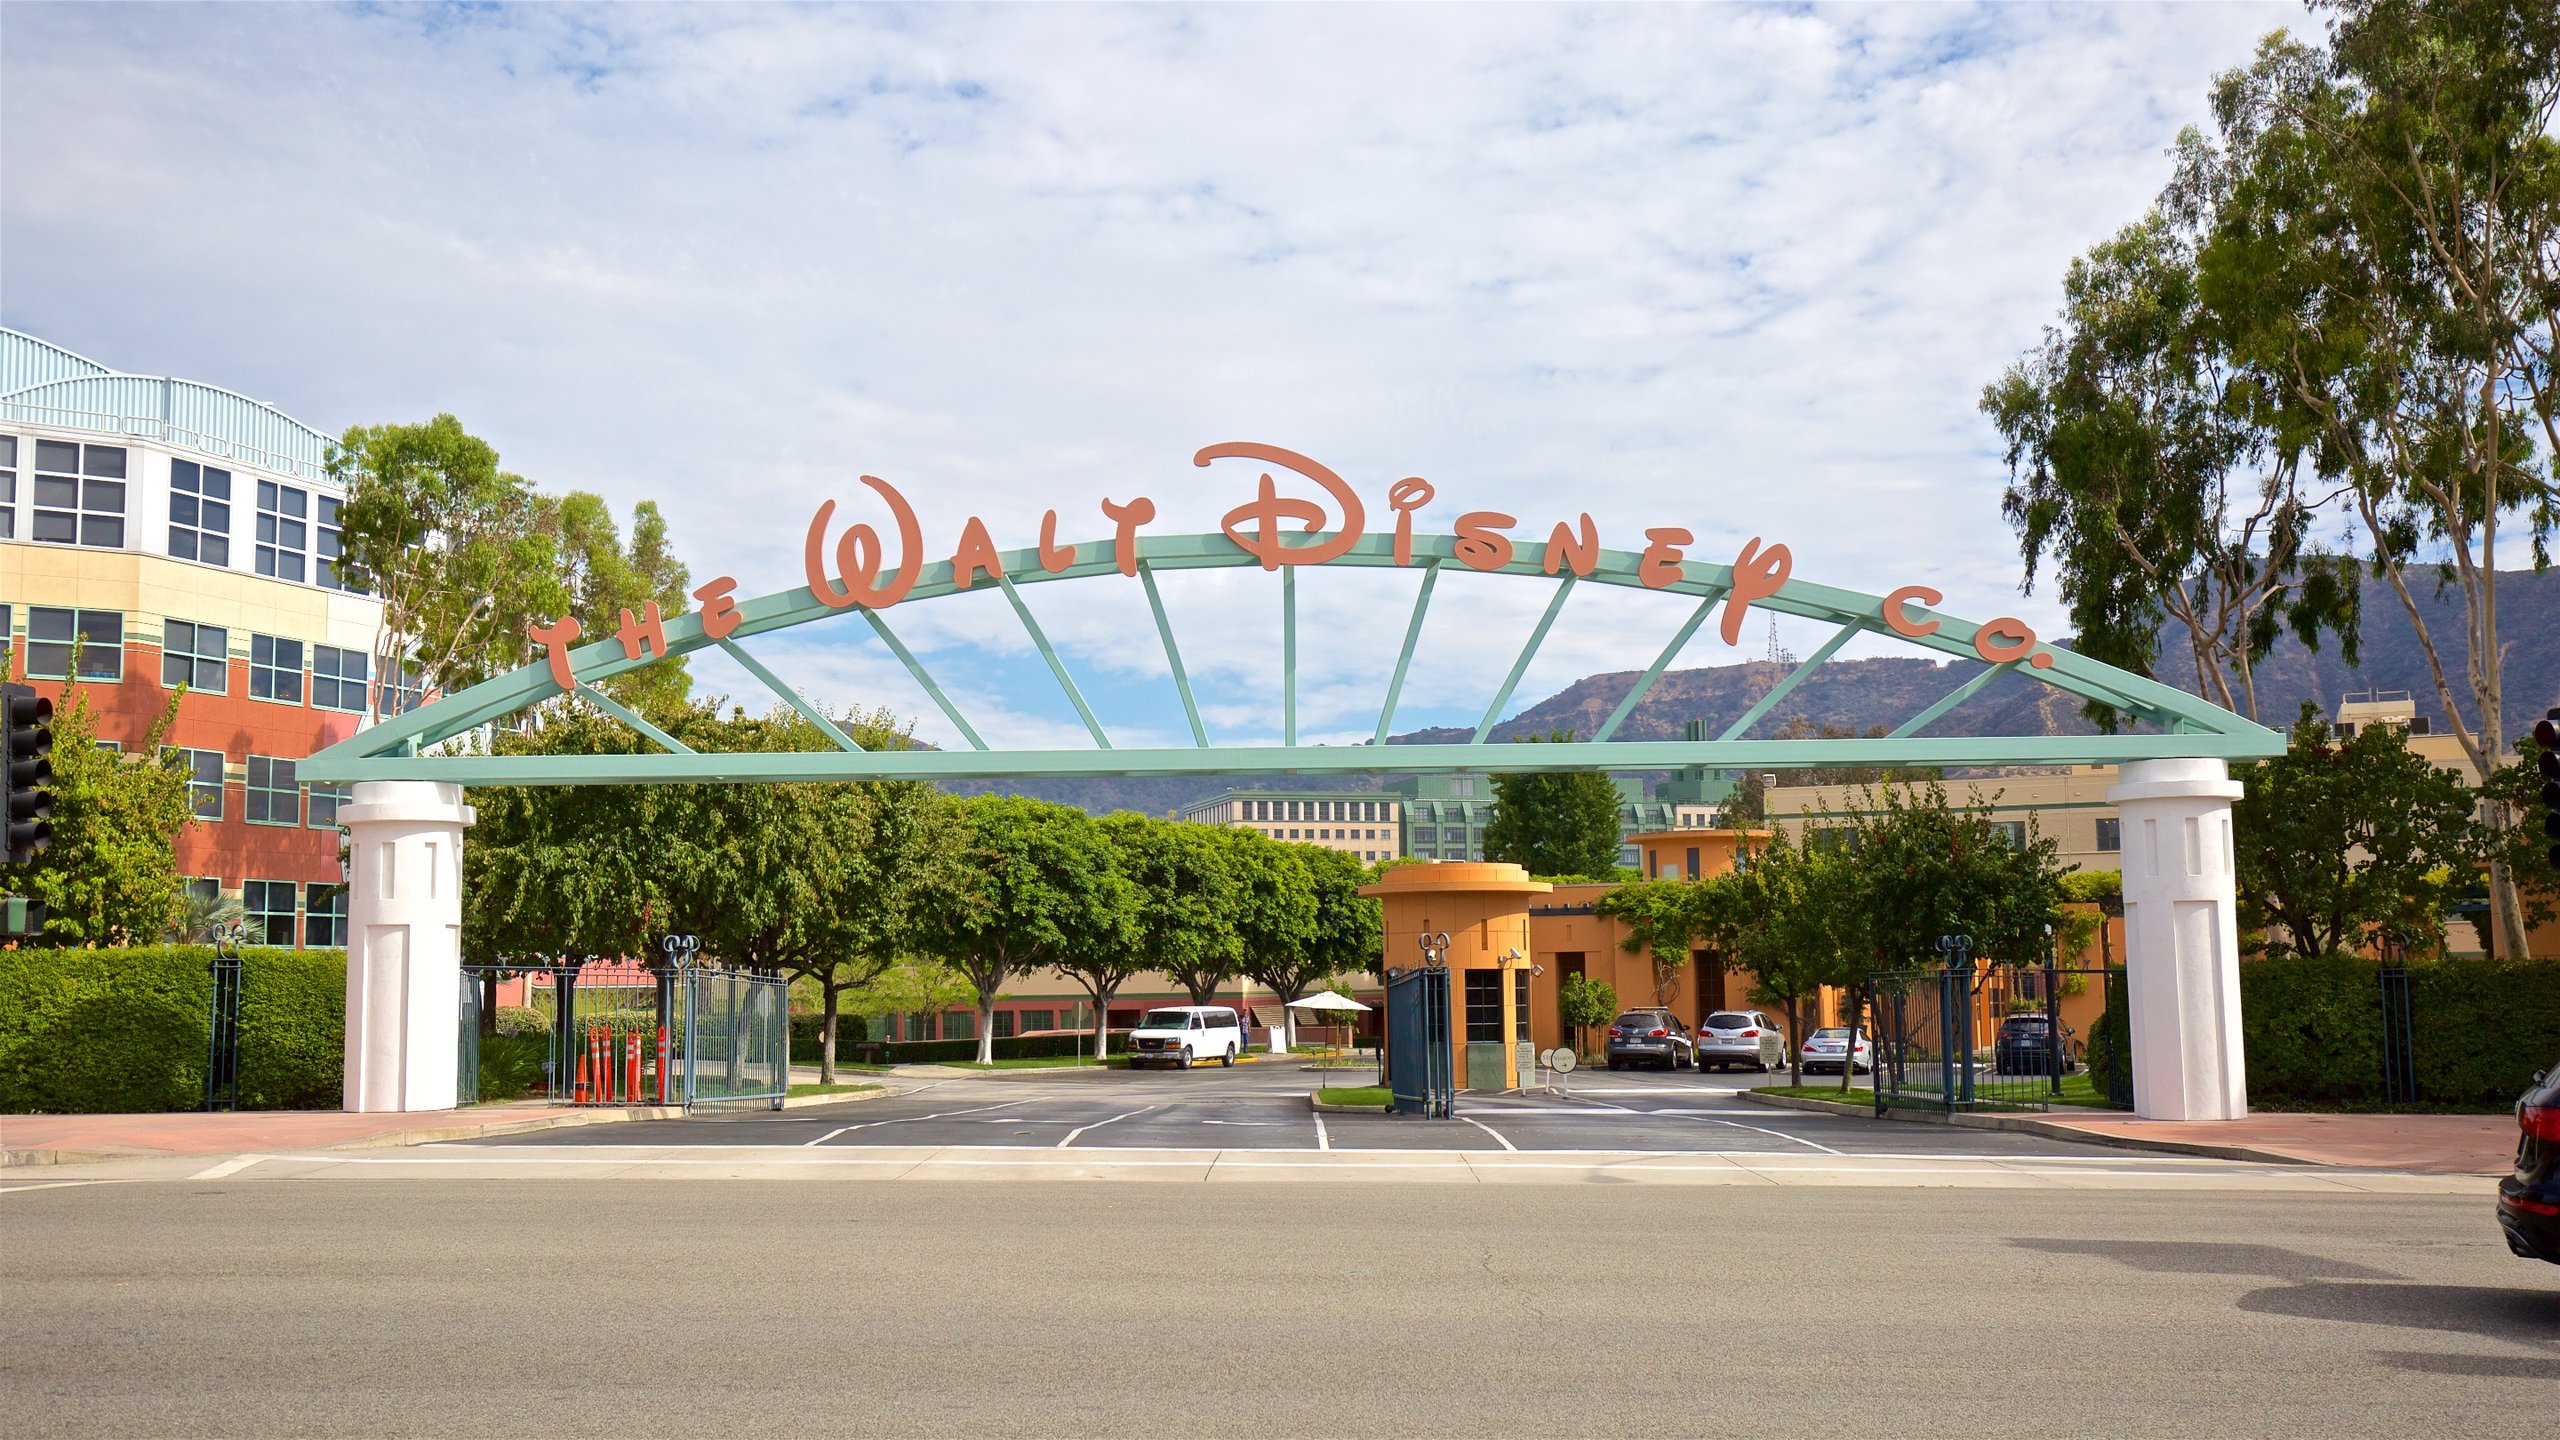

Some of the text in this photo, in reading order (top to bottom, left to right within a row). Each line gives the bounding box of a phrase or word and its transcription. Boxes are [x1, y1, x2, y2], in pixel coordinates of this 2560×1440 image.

[529, 441, 2054, 690] THE WALT DISNEY CO.
